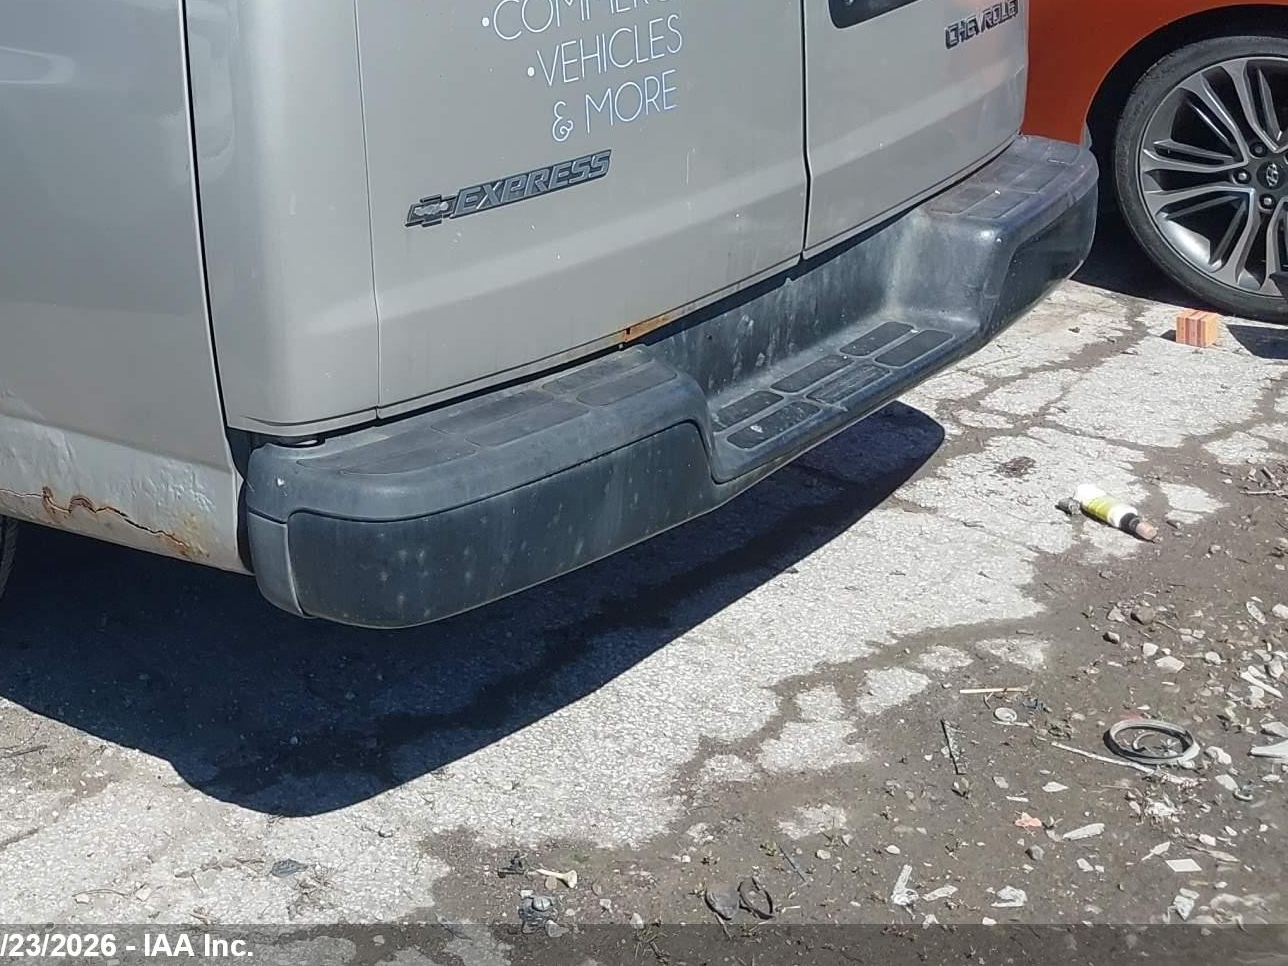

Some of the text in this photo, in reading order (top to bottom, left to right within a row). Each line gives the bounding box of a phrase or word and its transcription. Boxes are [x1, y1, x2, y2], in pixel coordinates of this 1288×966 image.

[536, 13, 684, 87] VEHICLES
[551, 69, 678, 142] & MORE
[453, 149, 612, 220] EXPRESS
